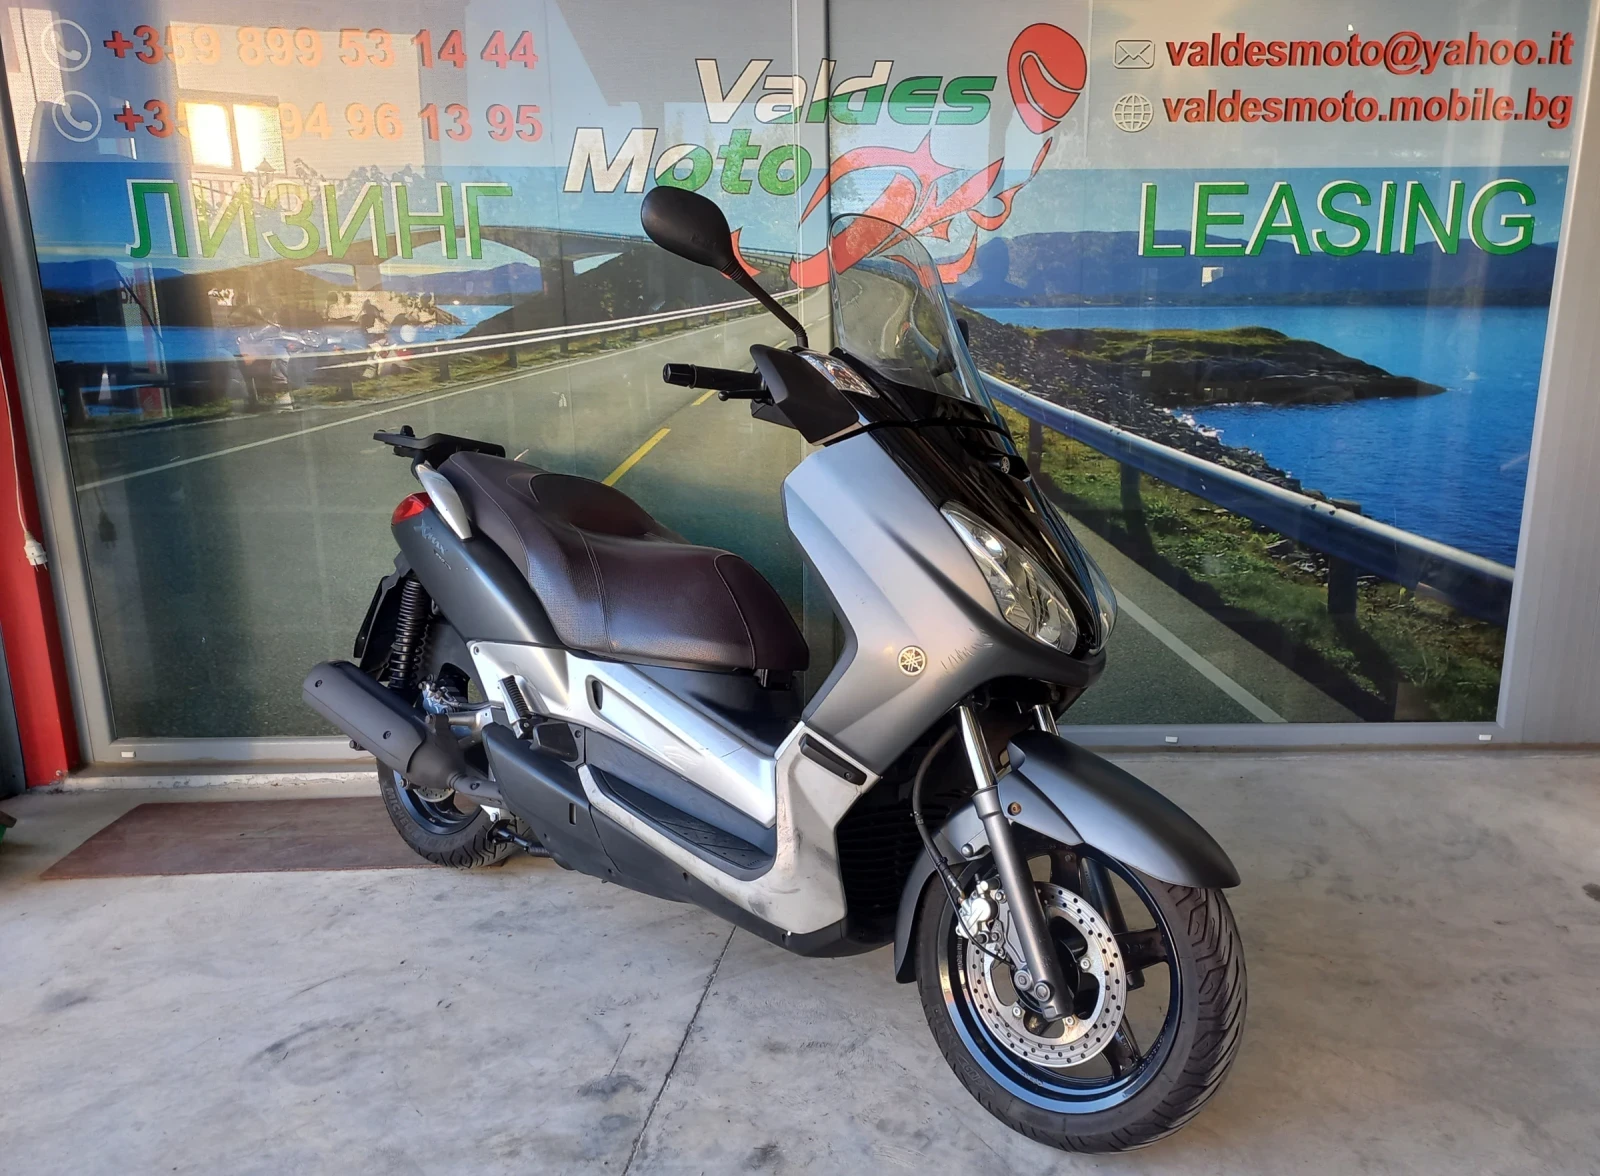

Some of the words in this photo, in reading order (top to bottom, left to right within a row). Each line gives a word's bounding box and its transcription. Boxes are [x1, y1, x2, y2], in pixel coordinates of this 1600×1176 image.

[103, 24, 221, 65] +359
[237, 26, 323, 67] 899
[339, 27, 395, 68] 53
[411, 28, 468, 69] 14
[480, 30, 539, 70] 44
[1166, 30, 1575, 75] valdesmoto@yahoo.it
[694, 57, 997, 126] Valdes
[1162, 87, 1574, 129] valdesmoto.mobile.bg
[346, 102, 403, 141] 96
[418, 102, 473, 143] 13
[486, 103, 543, 143] 95
[562, 127, 813, 197] Moto
[125, 179, 513, 260] ЛИЗИНГ
[1138, 179, 1537, 259] LEASING
